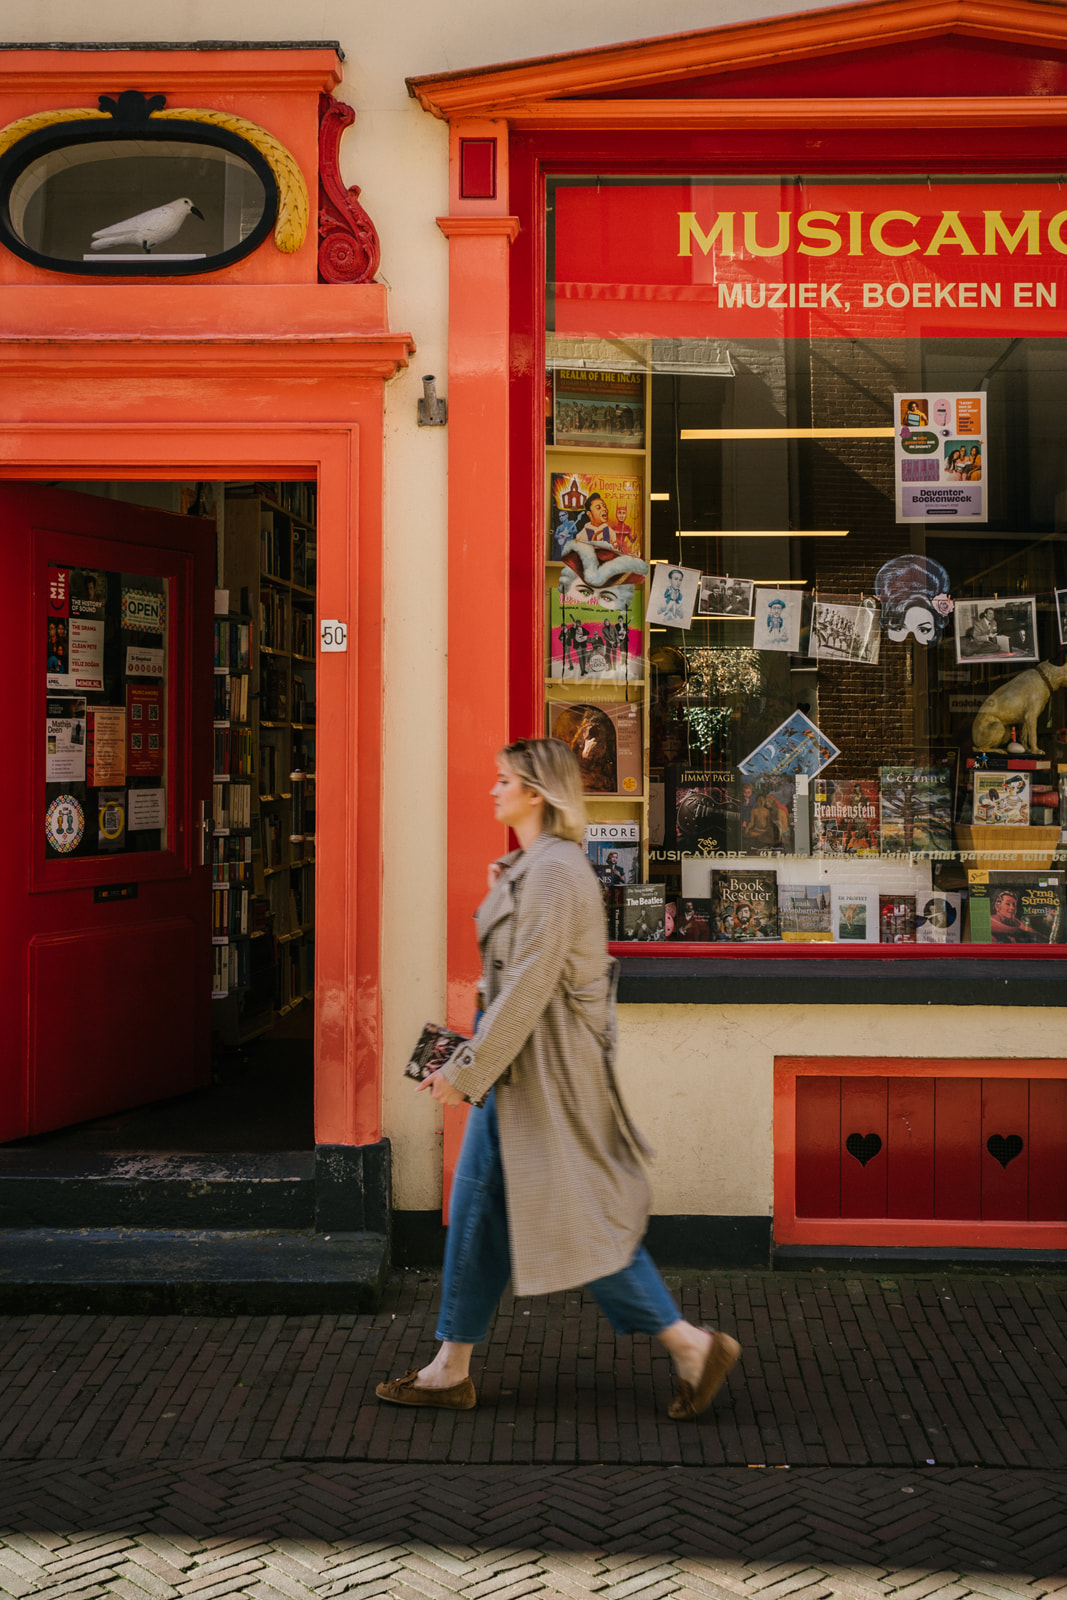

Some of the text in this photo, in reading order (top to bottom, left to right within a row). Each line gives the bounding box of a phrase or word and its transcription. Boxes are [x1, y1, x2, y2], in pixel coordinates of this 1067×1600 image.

[717, 283, 1057, 312] MUZIEK, BOEKEN EN
[560, 370, 587, 380] REALM
[588, 371, 599, 381] OF
[600, 372, 615, 382] THE
[617, 374, 641, 384] INCAS
[920, 489, 964, 497] Deventer
[128, 601, 159, 618] OPEN
[324, 626, 344, 645] 50
[52, 720, 72, 729] Mathijs
[681, 774, 735, 783] JIMMY PAGE
[886, 772, 947, 784] Cézanne
[646, 850, 747, 860] MUSICAMORE
[862, 850, 926, 861] imagined
[929, 851, 957, 861] that
[960, 851, 1018, 862] paradise
[1022, 851, 1049, 861] will
[730, 878, 765, 891] Book
[722, 888, 772, 902] Rescuer
[1026, 889, 1055, 899] Yma
[627, 896, 664, 906] The Beatles
[1021, 896, 1061, 906] Sumac
